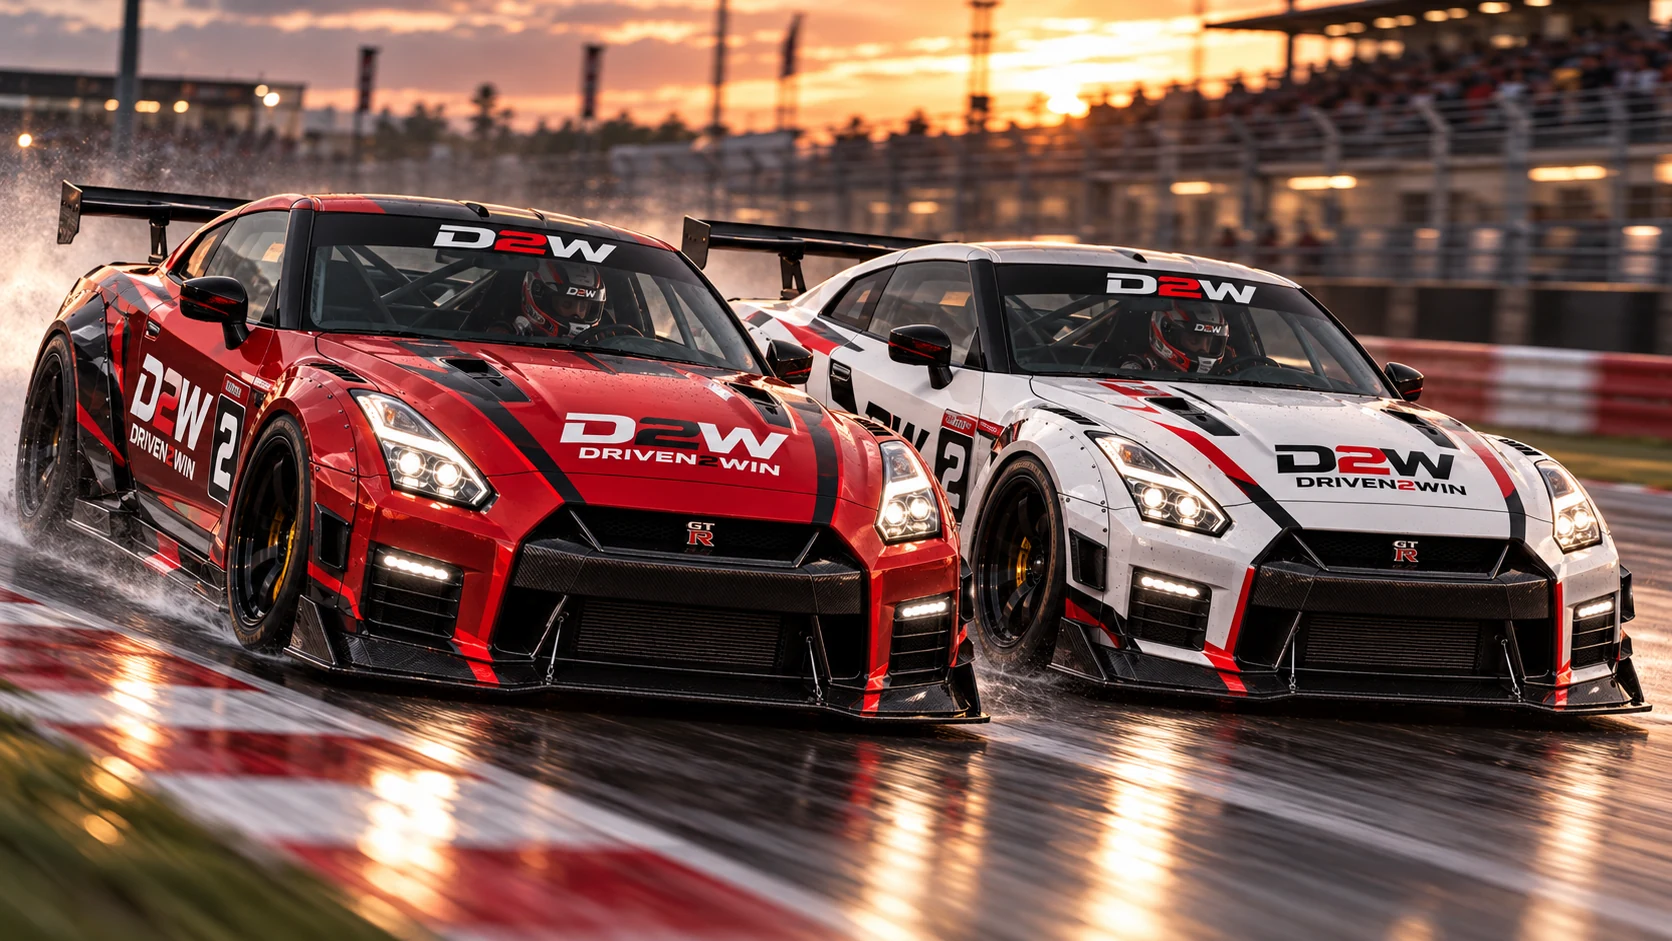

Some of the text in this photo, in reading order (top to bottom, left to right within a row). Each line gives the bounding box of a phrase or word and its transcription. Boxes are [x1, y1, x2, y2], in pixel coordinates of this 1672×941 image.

[433, 224, 617, 263] D2W
[566, 286, 597, 298] D2W
[1106, 272, 1257, 304] D2W
[1194, 323, 1222, 334] D2W
[130, 353, 214, 451] D2W
[129, 422, 196, 481] DRIVEN2WIN
[213, 411, 238, 492] 2
[560, 412, 789, 460] D2W
[578, 447, 780, 476] DRIVEN2WIN
[941, 441, 966, 509] 2
[1274, 444, 1455, 480] D2W
[1296, 477, 1467, 496] DRIVEN2WIN
[687, 521, 715, 530] GT
[1393, 540, 1419, 548] GT
